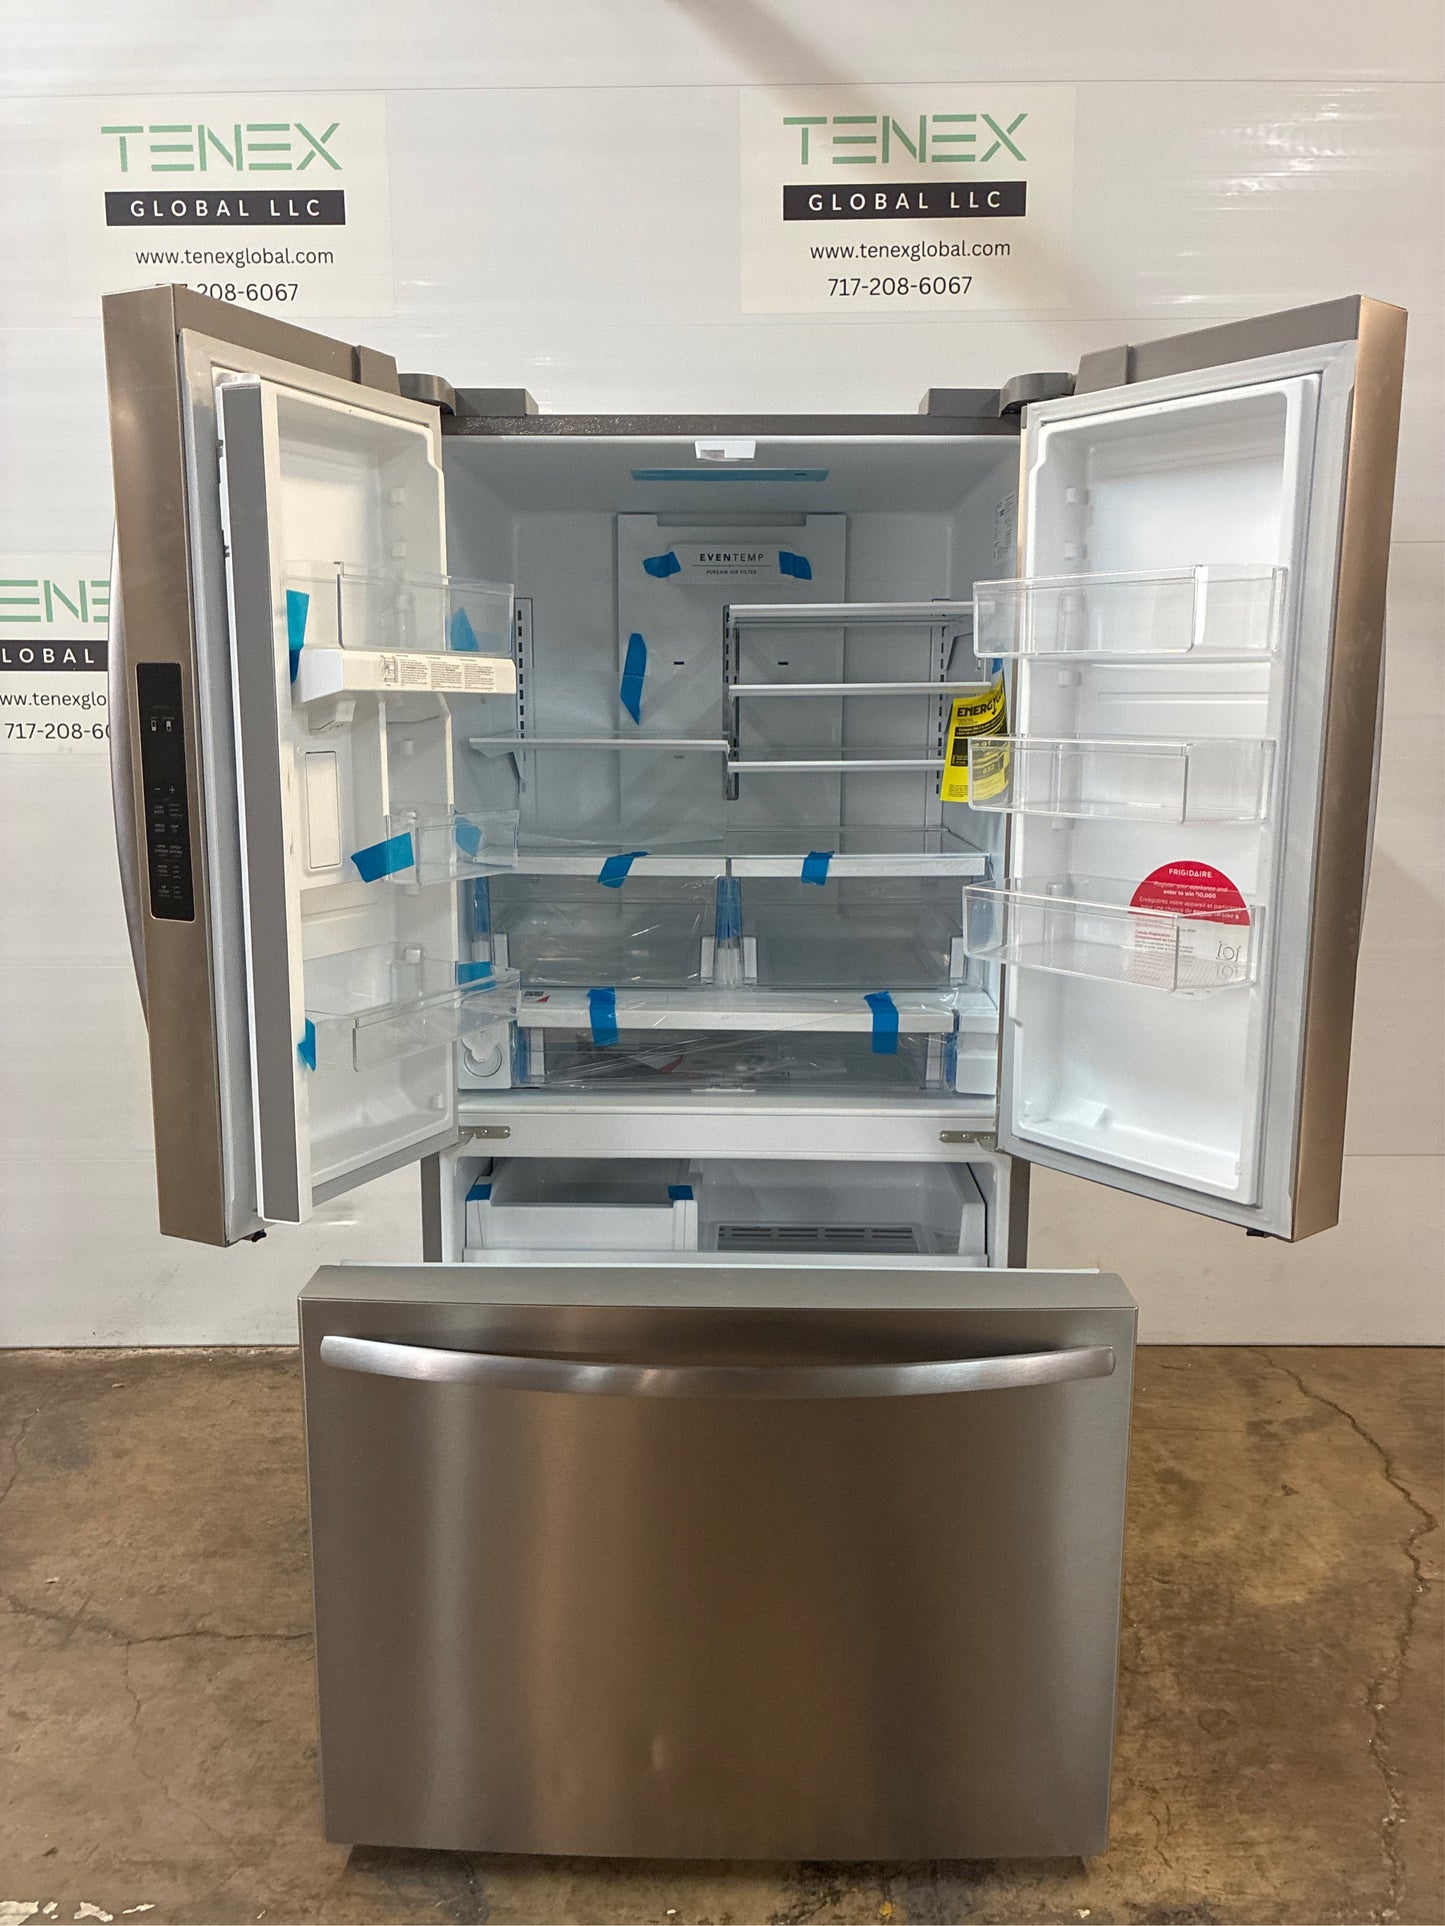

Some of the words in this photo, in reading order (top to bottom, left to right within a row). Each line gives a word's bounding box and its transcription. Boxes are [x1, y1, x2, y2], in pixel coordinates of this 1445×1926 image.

[101, 122, 343, 173] TENEX
[783, 113, 1029, 166] TENEX
[130, 199, 250, 219] GLOBAL
[270, 198, 322, 217] LLC
[808, 192, 928, 212] GLOBAL
[950, 190, 1001, 209] LLC
[135, 246, 334, 268] www.tenexglobal.com
[810, 239, 1011, 262] www.tenexglobal.com
[155, 283, 299, 302] 208-6067
[827, 276, 973, 297] 717-208-6067
[700, 553, 764, 562] EVENTEMP
[2, 648, 95, 664] LOBAL
[1168, 868, 1213, 879] FRIGIDAIRE
